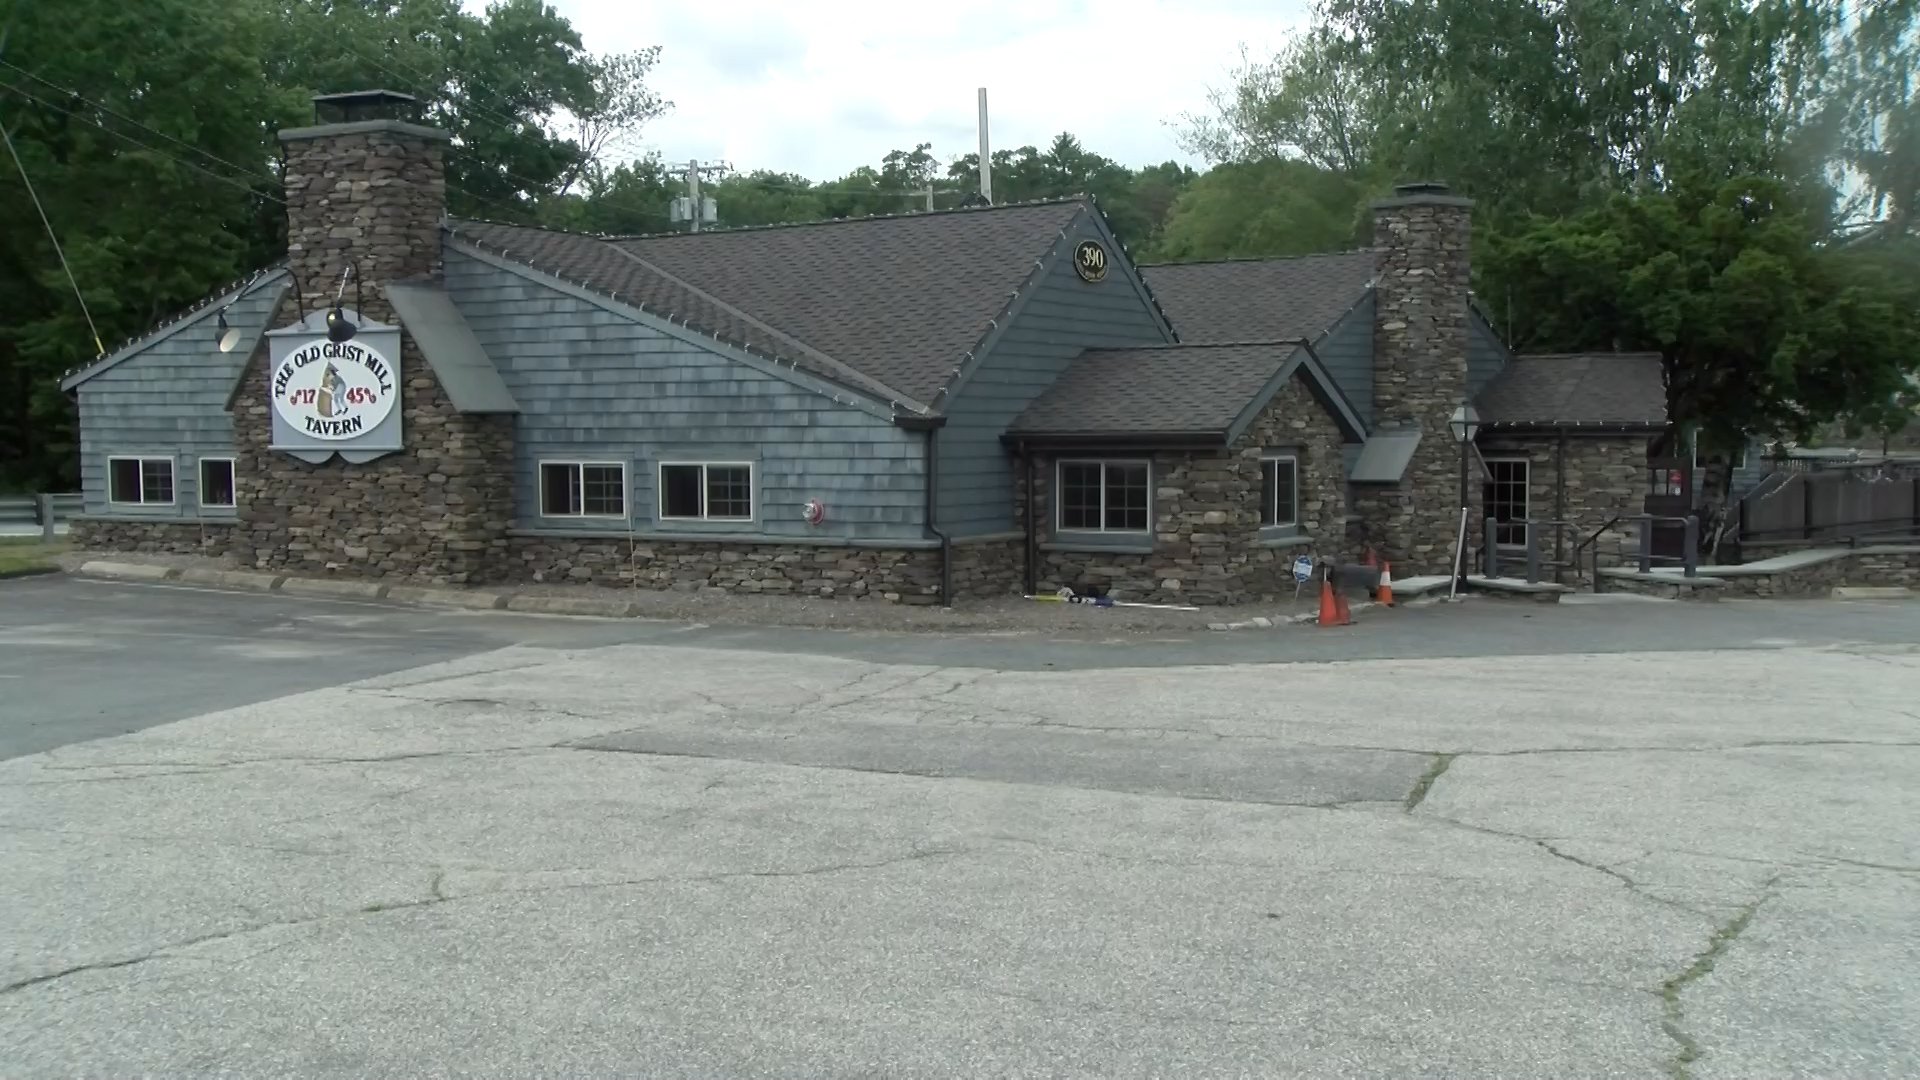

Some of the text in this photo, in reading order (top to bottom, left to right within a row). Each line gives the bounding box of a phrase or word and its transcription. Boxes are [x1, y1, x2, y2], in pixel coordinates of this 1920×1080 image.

[1082, 247, 1104, 268] 390
[275, 343, 392, 398] THE OLD GRIST MILL
[302, 387, 365, 404] 17 45
[305, 415, 362, 436] TAVERN
